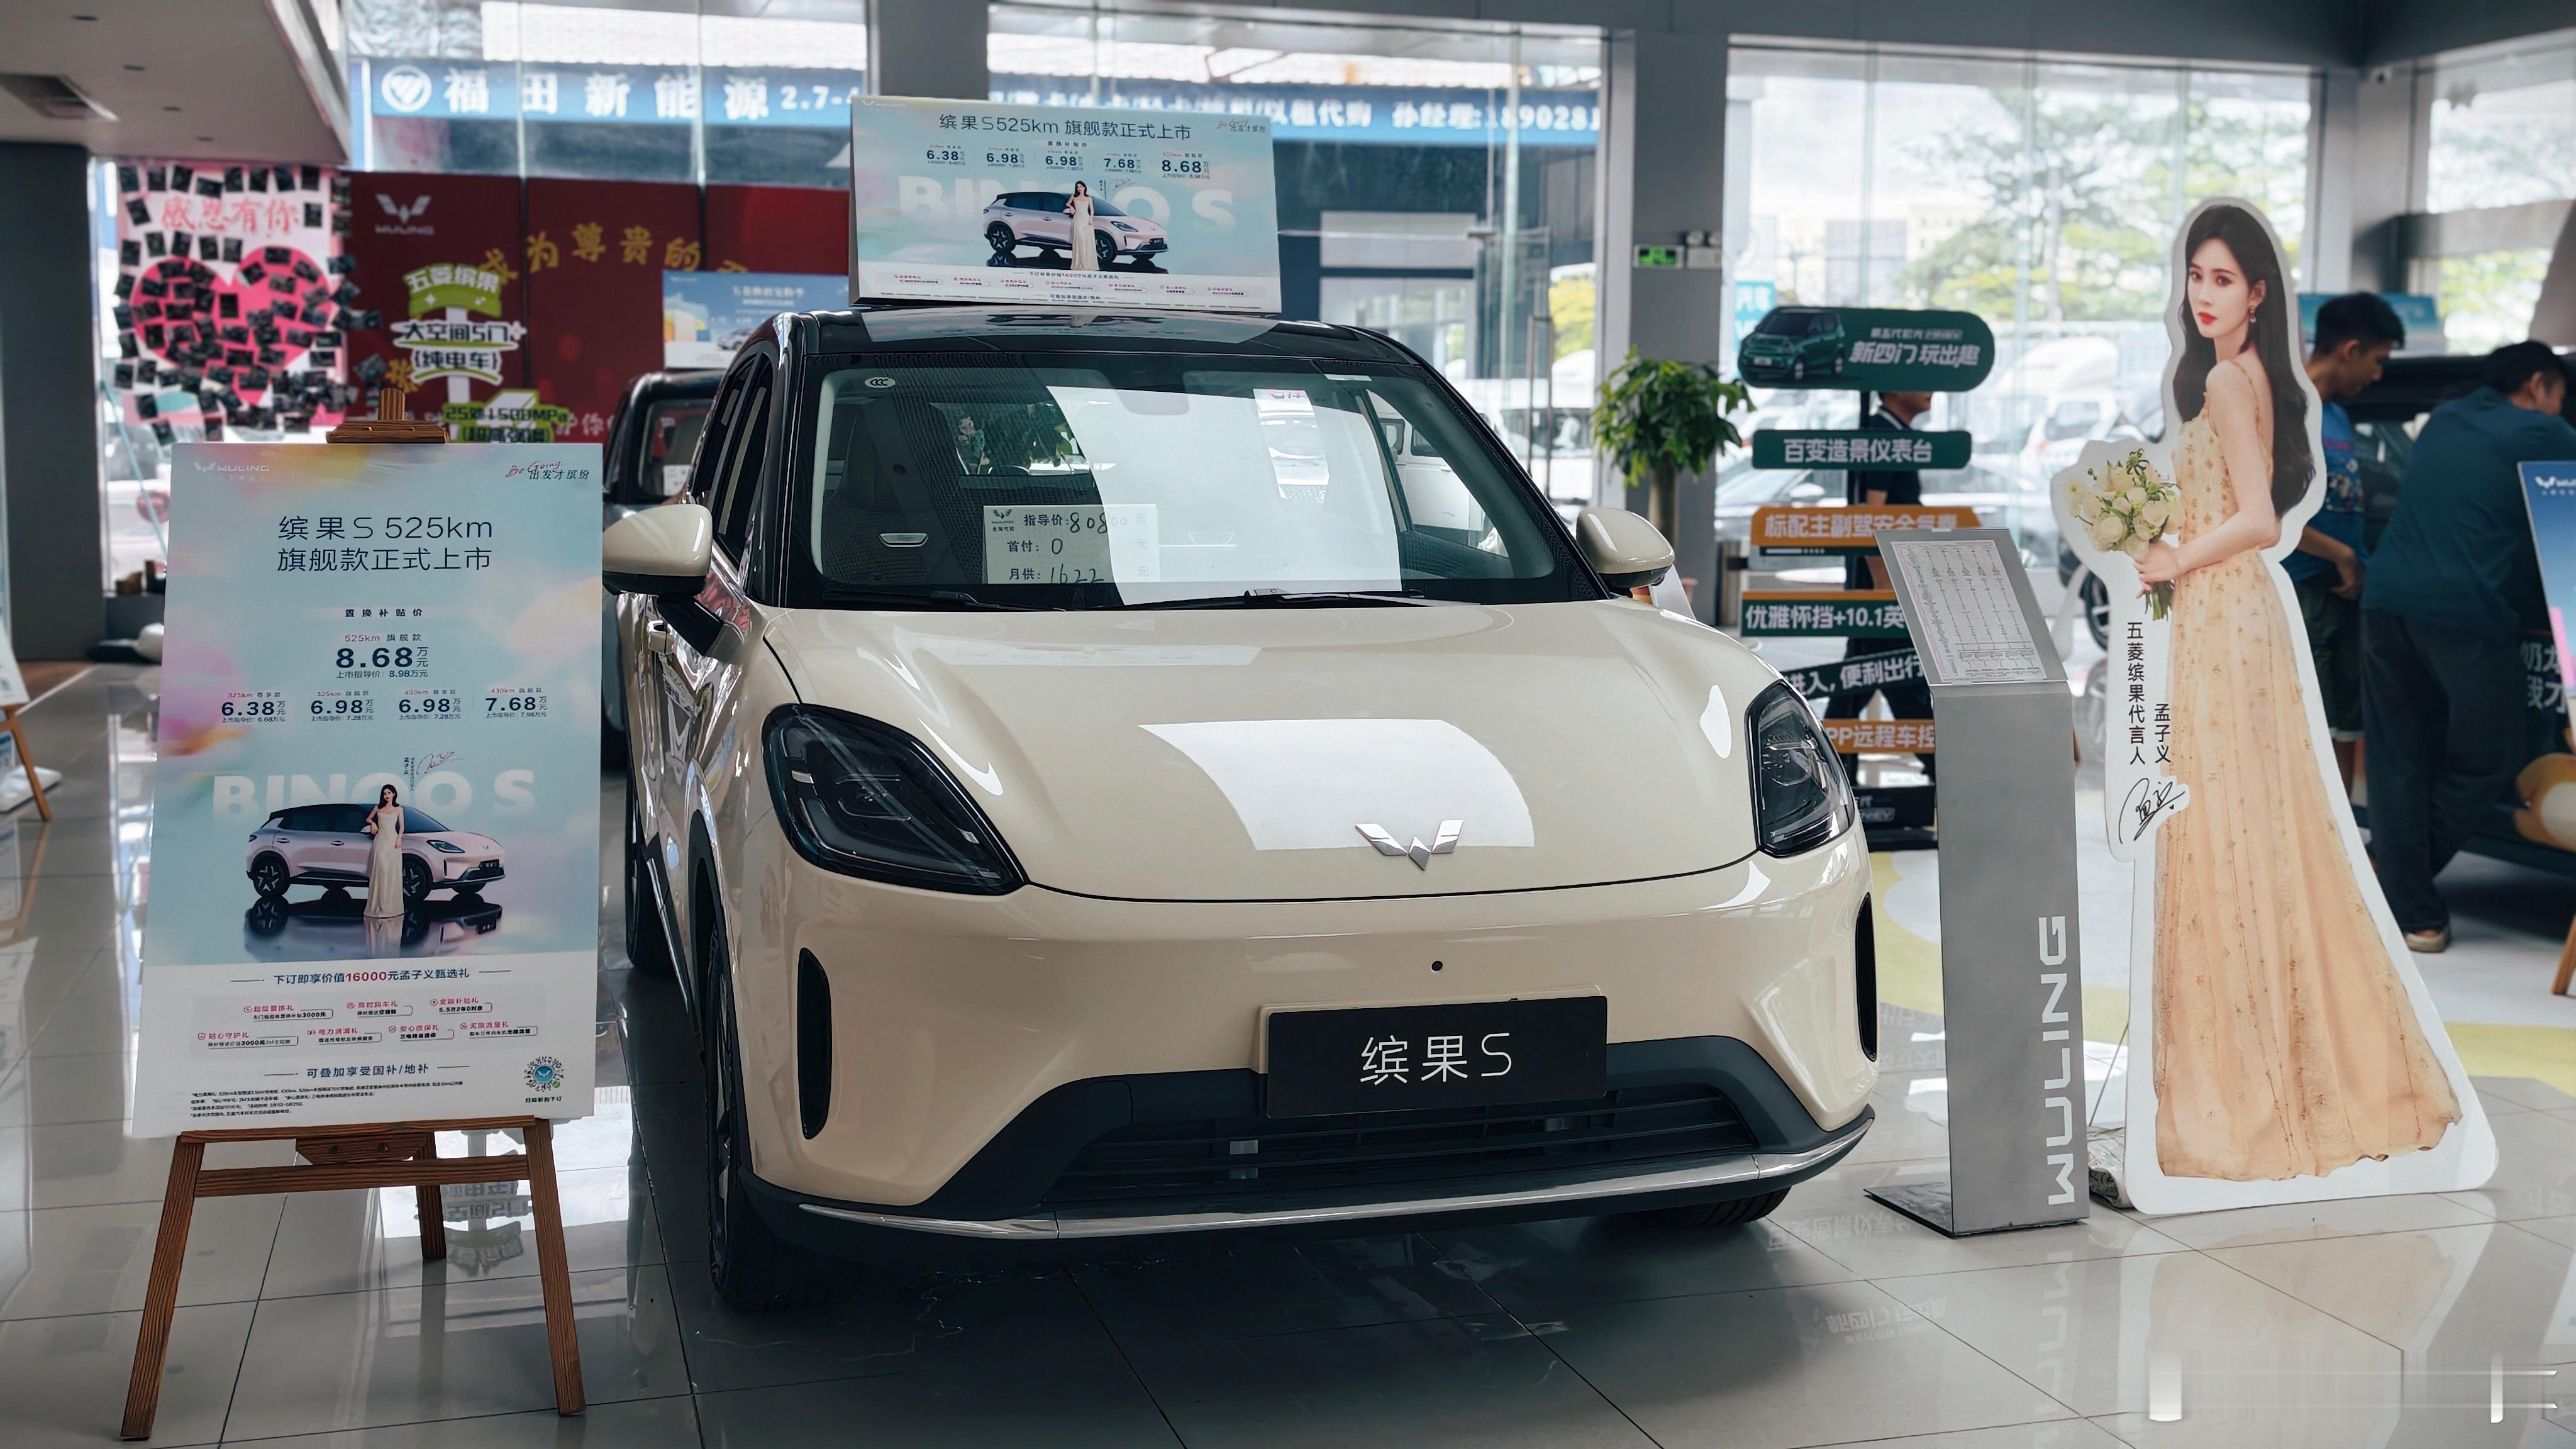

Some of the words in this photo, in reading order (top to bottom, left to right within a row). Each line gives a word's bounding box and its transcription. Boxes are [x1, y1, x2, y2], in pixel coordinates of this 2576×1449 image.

[443, 66, 769, 120] 福田新能源
[1065, 119, 1191, 140] 旗舰款正式上市
[927, 150, 959, 161] 6.38
[986, 153, 1018, 164] 6.98
[1045, 156, 1077, 166] 6.98
[1104, 158, 1135, 169] 7.68
[1162, 160, 1202, 173] 8.68
[408, 264, 501, 294] 五菱缤果
[404, 322, 508, 342] 大空间5门
[1784, 438, 1933, 464] 百变造景仪表台
[278, 515, 374, 541] 缤果S
[385, 516, 493, 539] 525km
[1007, 540, 1039, 553] 首付:
[1051, 538, 1063, 555] 0
[277, 547, 492, 572] 旗舰款正式上市
[1009, 568, 1041, 580] 月供:
[345, 608, 423, 618] 置换补贴价
[336, 647, 413, 669] 8.68
[2127, 621, 2146, 765] 五菱缤果代言人
[221, 701, 275, 716] 6.38
[311, 700, 364, 714] 6.98
[399, 699, 451, 713] 6.98
[485, 697, 536, 711] 7.68
[2154, 703, 2172, 764] 孟子义
[213, 770, 473, 818] BINO
[1360, 1033, 1512, 1085] 缤果S
[2038, 916, 2075, 1205] WULING
[306, 1063, 429, 1079] 可叠加享受国补/地补
